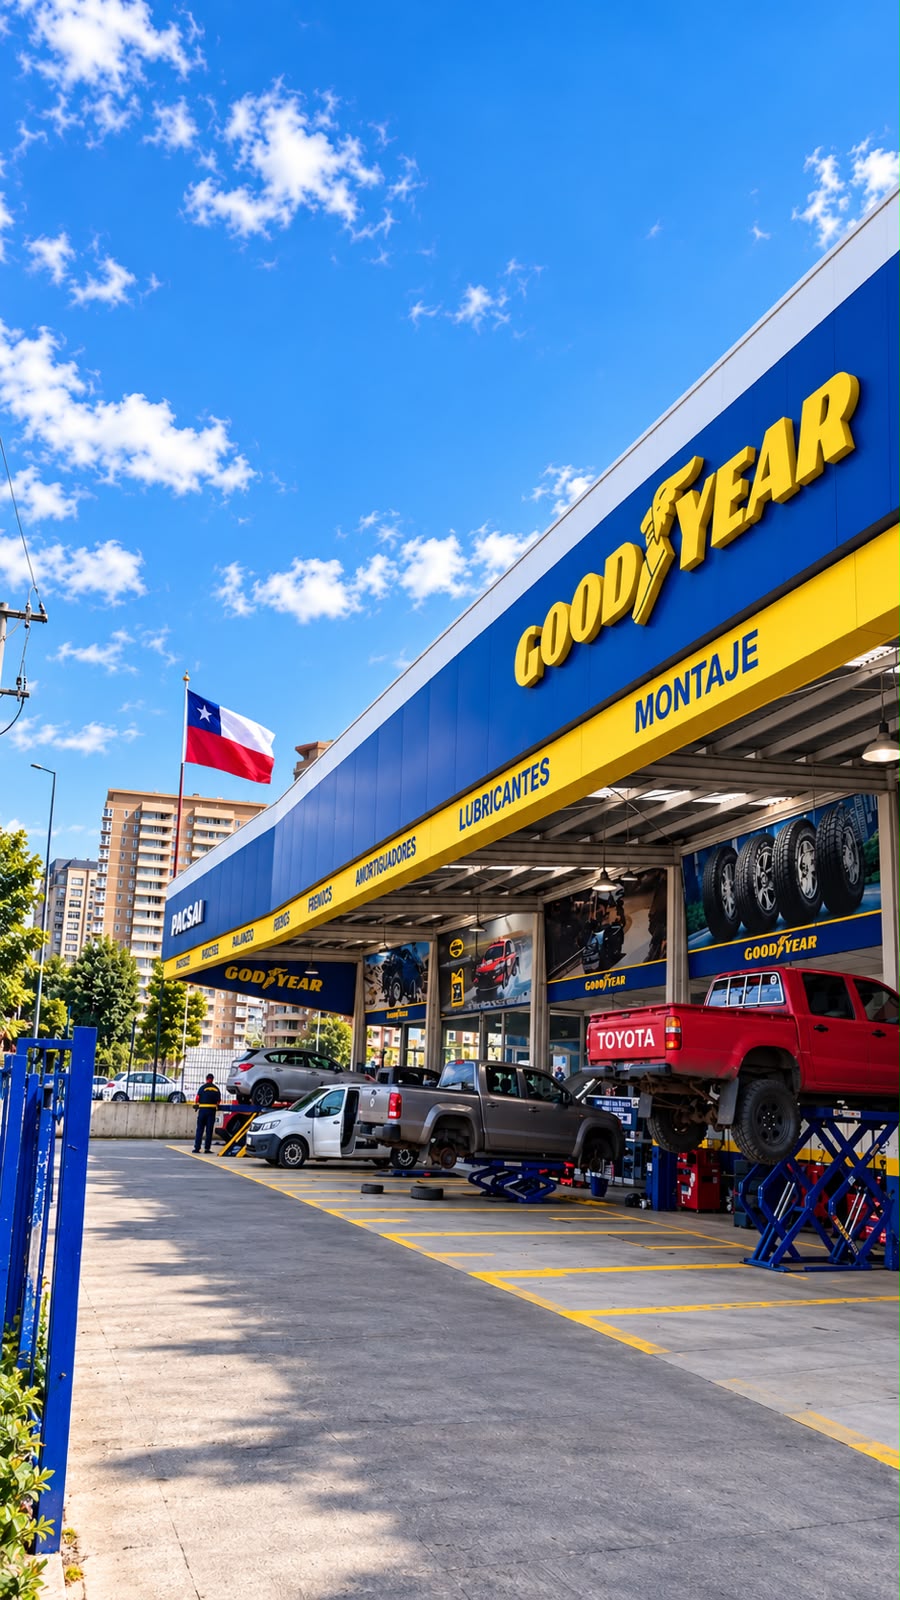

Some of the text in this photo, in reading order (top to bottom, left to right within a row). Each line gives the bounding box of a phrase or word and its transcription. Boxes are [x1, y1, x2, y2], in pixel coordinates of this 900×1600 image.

[514, 371, 860, 688] GOODYEAR
[634, 629, 759, 733] MONTAJE
[459, 757, 551, 832] LUBRICANTES
[355, 836, 417, 887] AMORTIGUADORES
[171, 899, 204, 937] PACSAI
[744, 934, 817, 961] GOODYEAR
[585, 973, 626, 991] GOODYEAR
[597, 1028, 655, 1050] TOYOTA
